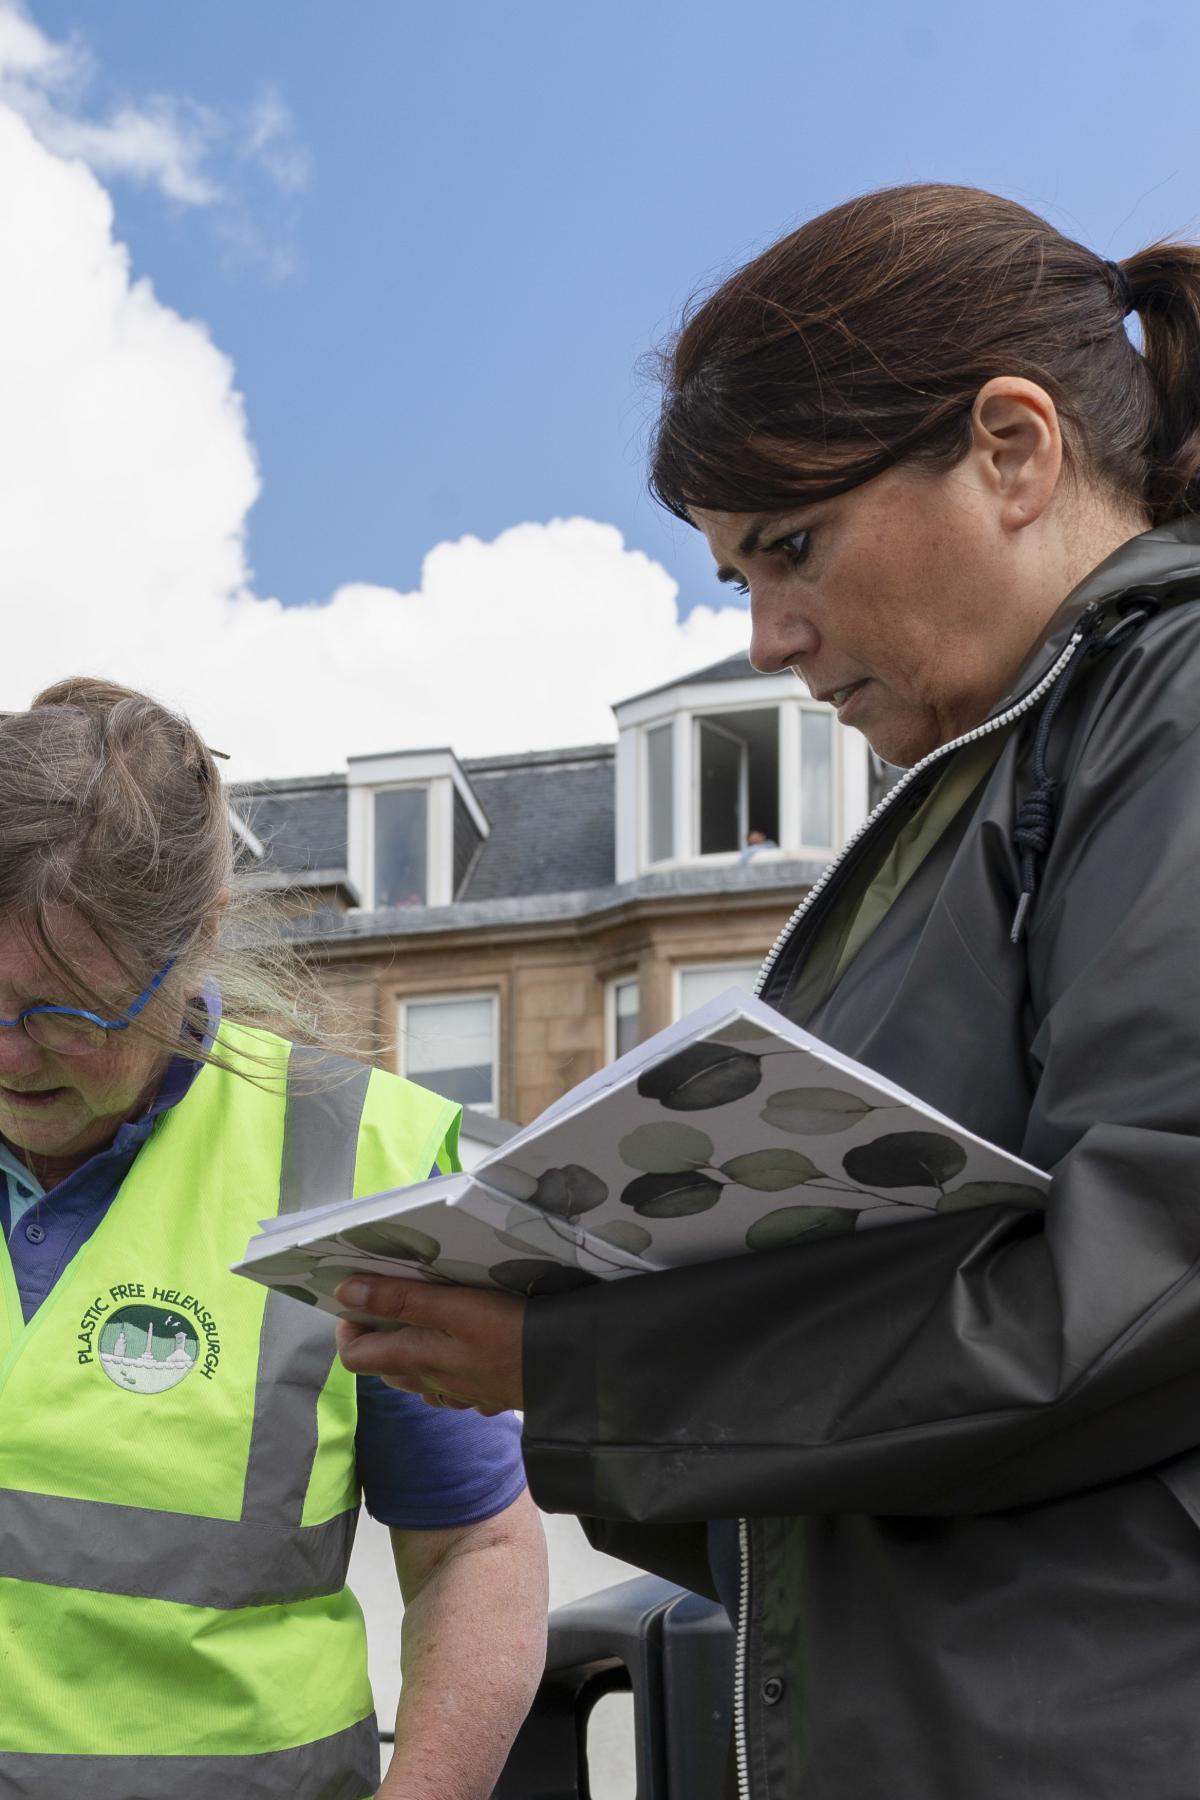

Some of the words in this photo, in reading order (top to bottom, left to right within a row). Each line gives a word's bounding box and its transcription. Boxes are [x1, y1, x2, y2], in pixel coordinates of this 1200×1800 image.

[77, 1297, 110, 1365] PLASTIC
[109, 1283, 146, 1302] FREE
[152, 1287, 220, 1380] HELENSBURGH
